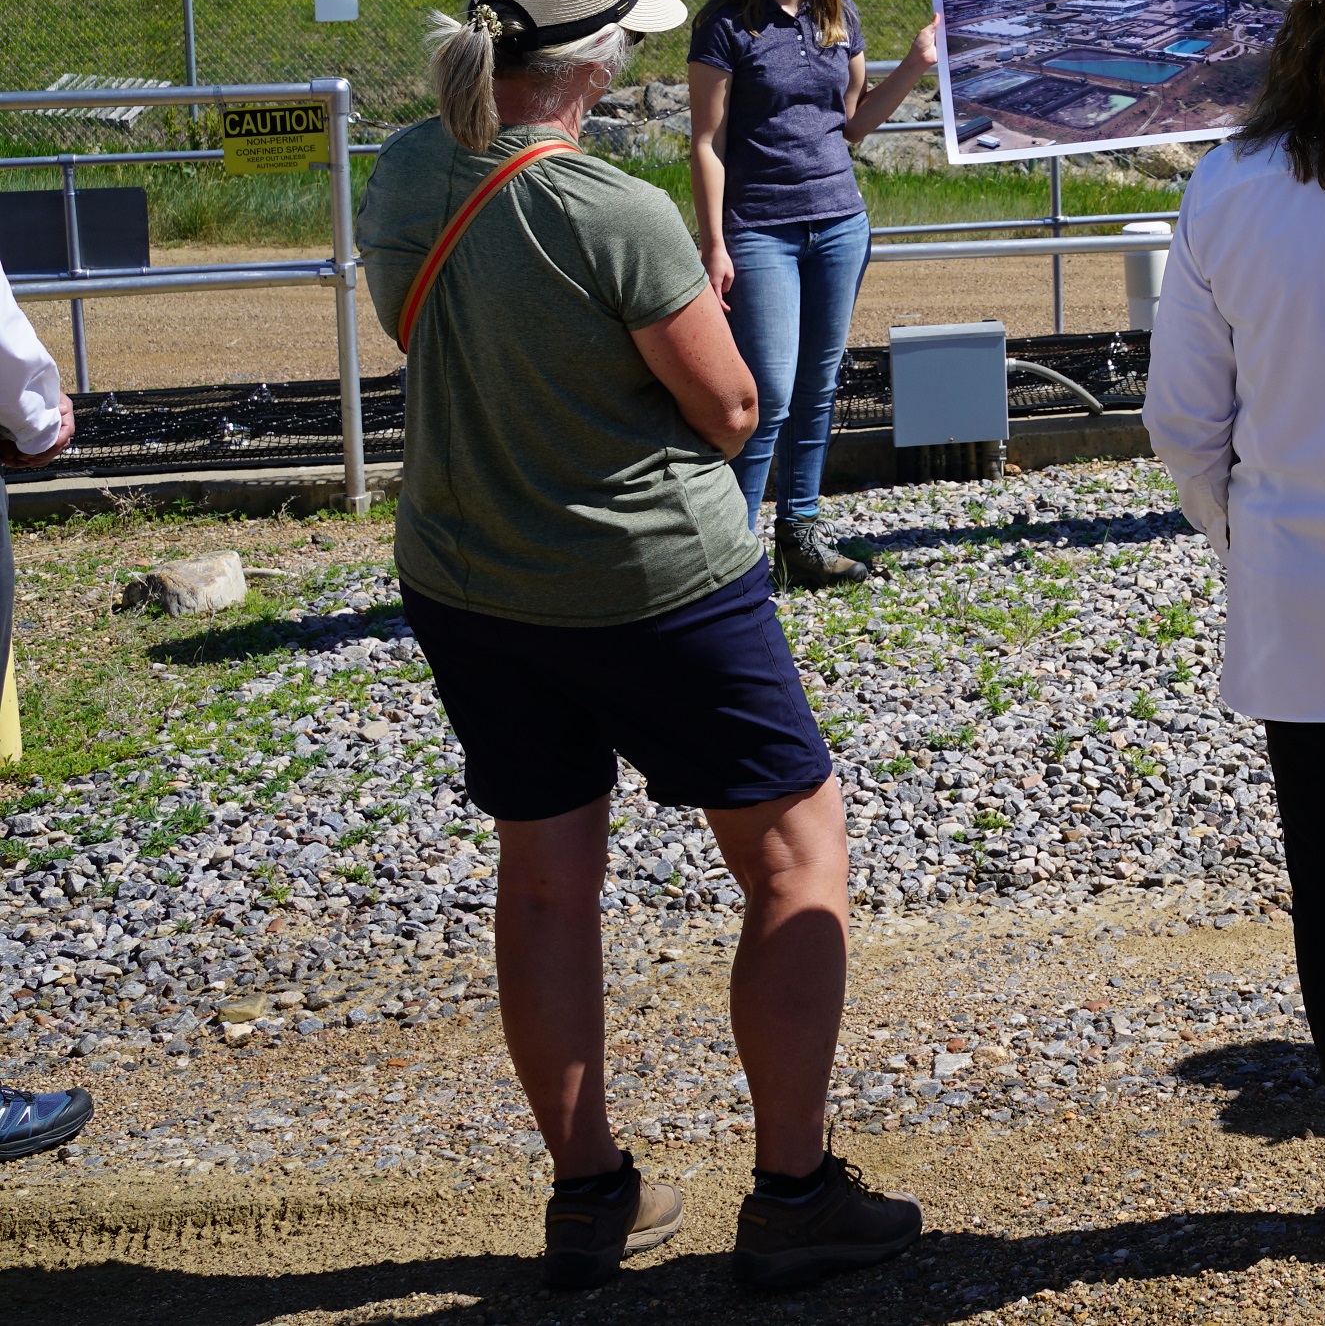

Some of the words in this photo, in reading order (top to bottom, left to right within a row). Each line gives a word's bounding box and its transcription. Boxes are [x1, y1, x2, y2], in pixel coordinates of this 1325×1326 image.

[225, 109, 323, 135] CAUTION
[246, 135, 304, 146] NON-PERMIT
[236, 146, 284, 157] CONFINED
[286, 144, 317, 154] SPACE
[256, 161, 298, 169] AUTHORIZED
